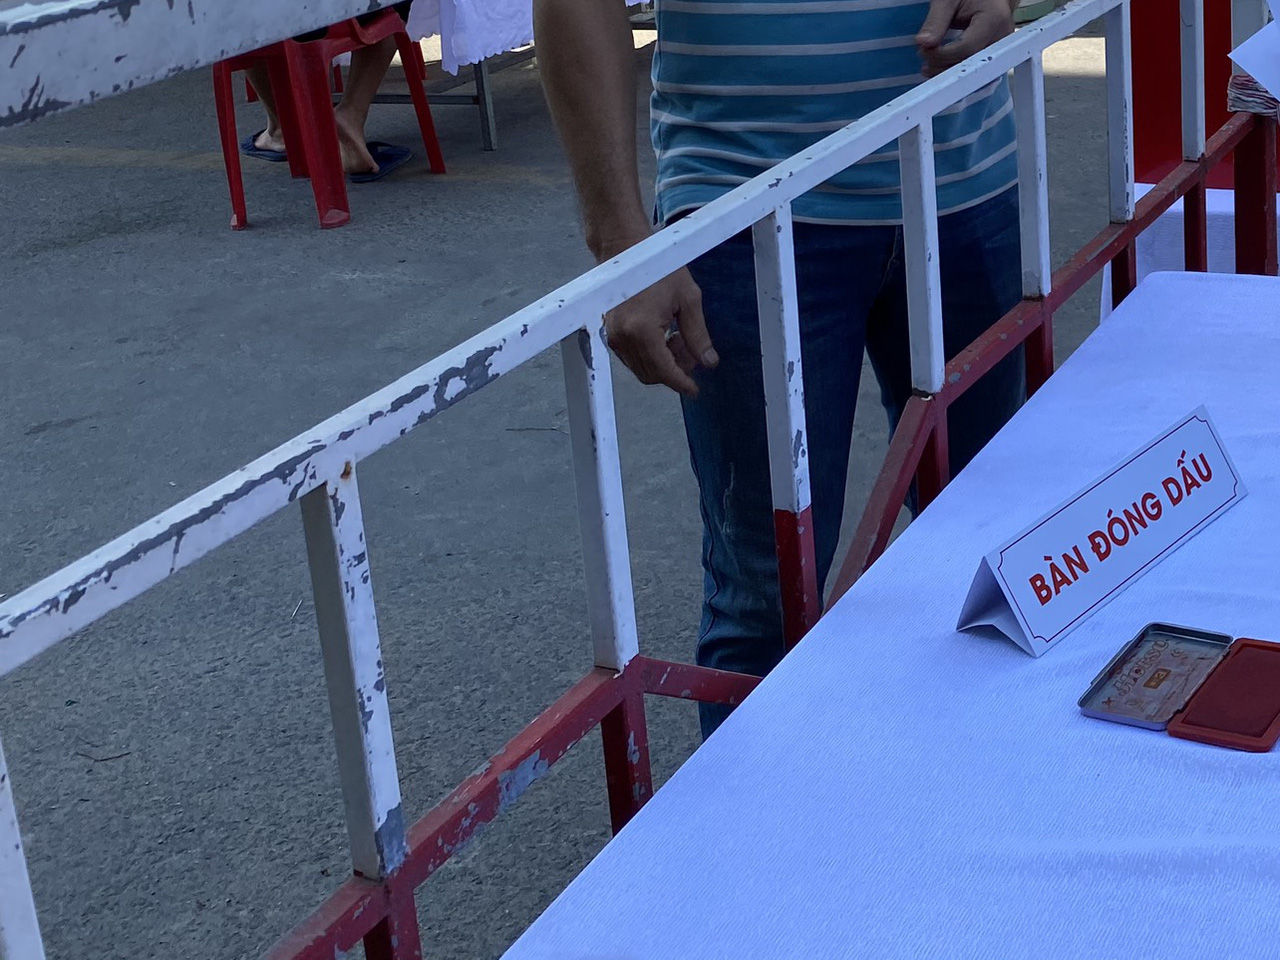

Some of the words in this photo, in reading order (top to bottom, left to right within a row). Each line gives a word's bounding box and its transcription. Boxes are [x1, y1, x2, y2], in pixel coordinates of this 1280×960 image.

[1028, 545, 1090, 607] BÀN
[1087, 492, 1163, 562] ĐÓNG
[1161, 449, 1213, 507] DẤU
